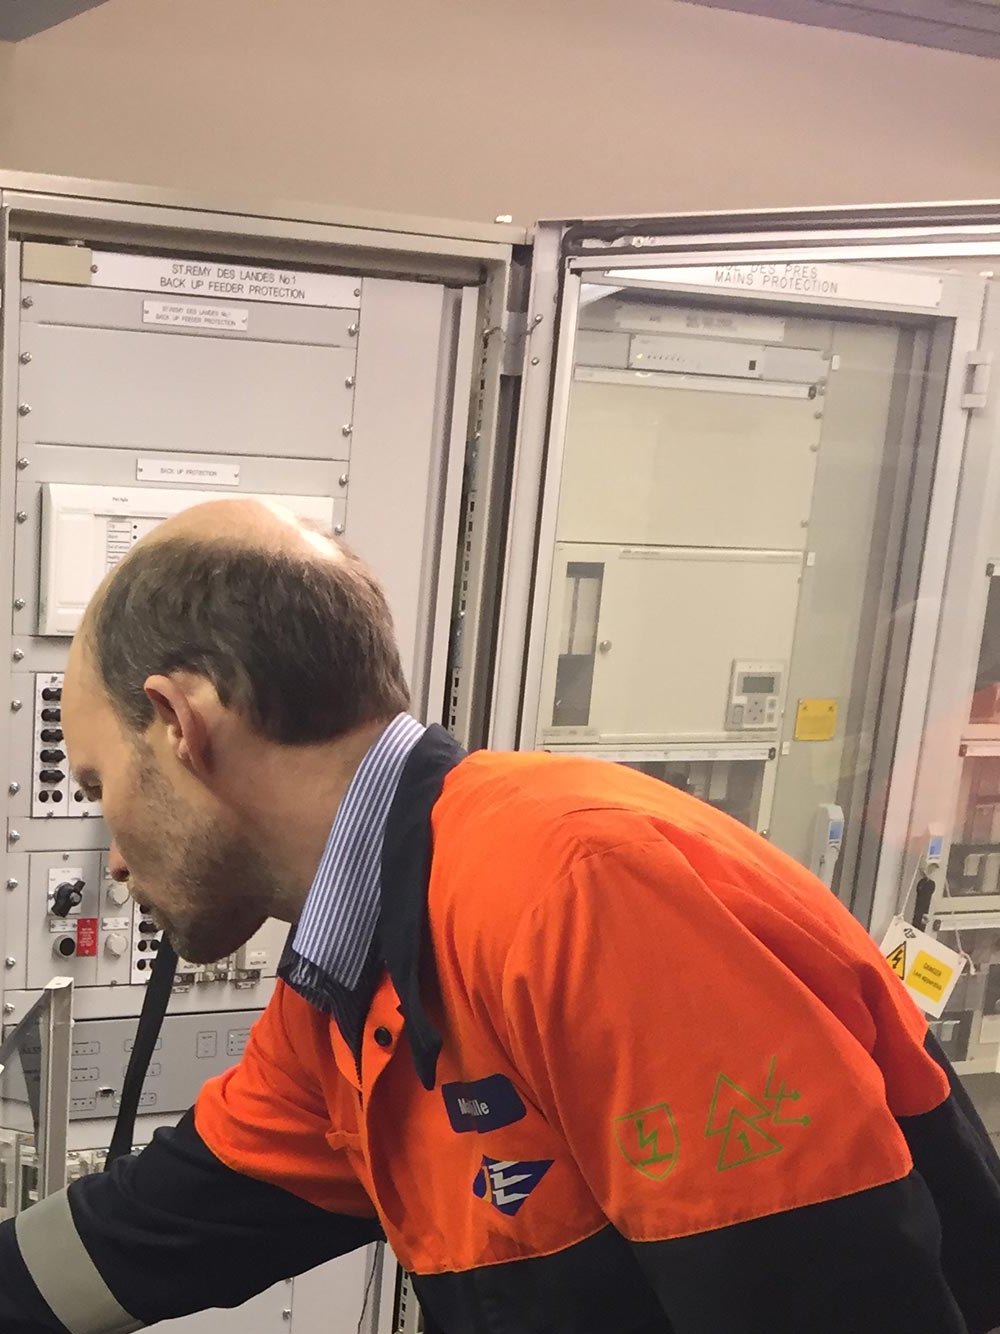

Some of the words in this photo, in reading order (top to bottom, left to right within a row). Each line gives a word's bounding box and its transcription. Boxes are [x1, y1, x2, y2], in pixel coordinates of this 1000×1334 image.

[217, 268, 235, 279] DES
[240, 271, 275, 283] LANDES
[715, 271, 754, 285] MAINS
[763, 274, 838, 293] PROTECTION
[160, 277, 186, 288] BACK
[191, 280, 204, 289] UP
[209, 281, 244, 293] FEEDER
[249, 285, 305, 299] PROTECTION
